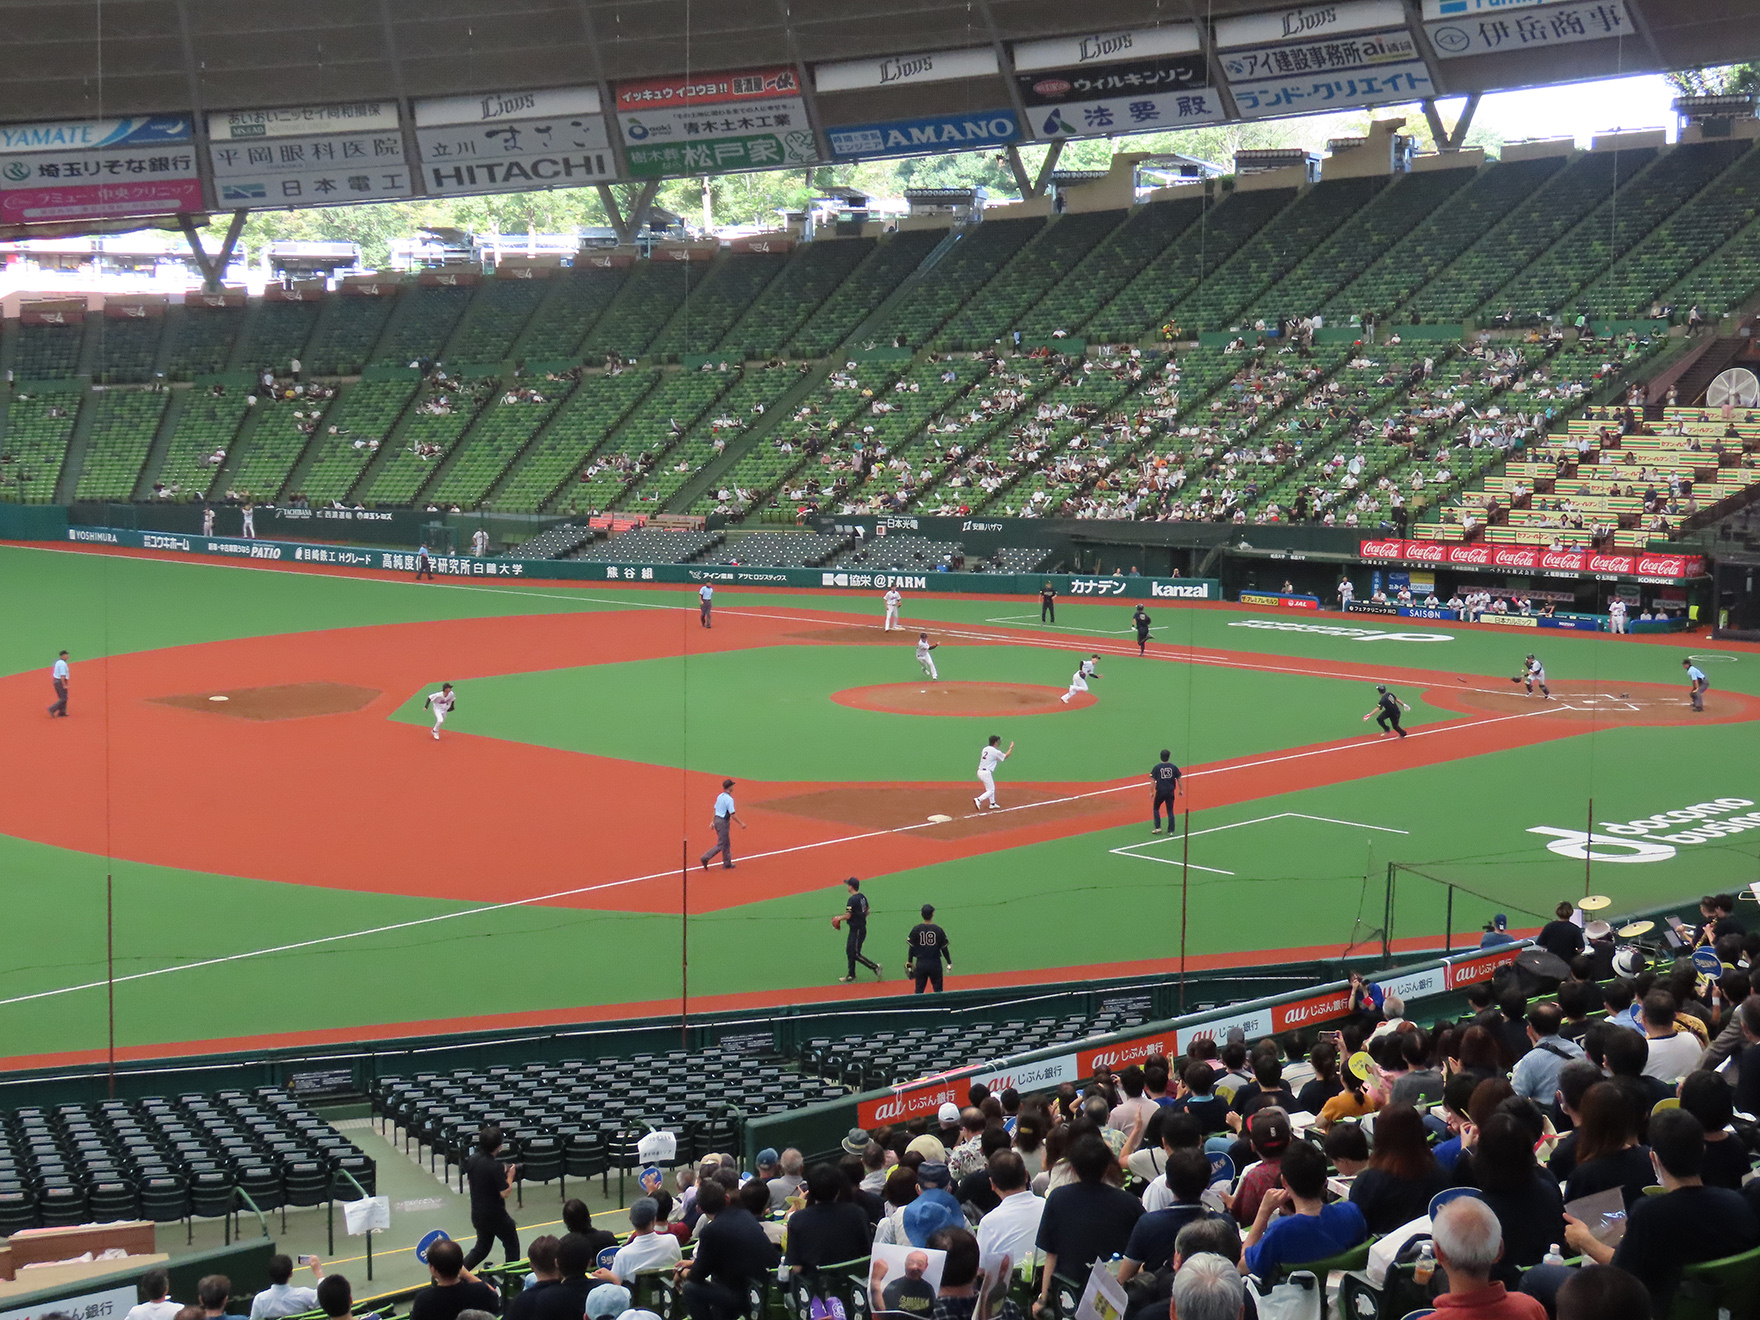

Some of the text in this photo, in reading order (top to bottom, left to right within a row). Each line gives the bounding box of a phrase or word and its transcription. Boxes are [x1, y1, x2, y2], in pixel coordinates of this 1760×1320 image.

[1281, 8, 1337, 38] Lions
[1079, 33, 1133, 63] Lions
[1242, 41, 1363, 76] アイ建設事務所
[879, 56, 933, 84] Lions
[1035, 83, 1070, 93] WILKINSON
[1073, 68, 1193, 92] ウィルキンソン
[622, 87, 673, 103] イッキュウ
[228, 104, 381, 125] あいおいニッセイ同和損保
[480, 93, 536, 120] Lions
[1084, 95, 1212, 127] 法要殿
[683, 114, 791, 135] 青木土木工業
[886, 118, 1014, 148] AMANO
[2, 125, 94, 147] YAMATE
[218, 138, 400, 167] 平岡眼科医院
[682, 139, 781, 168] 松戸家
[37, 155, 192, 178] 埼玉りそな銀行
[432, 154, 605, 187] HITACHI
[282, 174, 404, 197] 日本電工
[887, 518, 919, 530] 日本光電
[75, 530, 117, 543] YOSHIMURA
[250, 546, 281, 560] PATIO
[339, 552, 372, 565] Hグレード
[1363, 541, 1399, 558] Coca-Cola
[1407, 543, 1443, 560] Coca-Cola
[1451, 546, 1487, 564] Coca-Cola
[1496, 548, 1534, 566] Coca-Cola
[1543, 551, 1581, 569] Coca-Cola
[1590, 553, 1631, 572] Coca-Cola
[1639, 557, 1678, 575] Coca-Cola
[606, 566, 654, 580] 熊谷組
[849, 574, 872, 587] 協栄
[1638, 577, 1674, 586] KONOIKE
[1071, 579, 1127, 595] カナデン
[1409, 609, 1441, 619] SAISON
[1160, 767, 1172, 778] 13
[1598, 797, 1755, 835] docomo
[919, 931, 936, 946] 18
[1456, 965, 1479, 982] au
[1397, 978, 1433, 996] じぶん銀行
[1285, 998, 1349, 1024] au じぶん銀行
[1092, 1041, 1164, 1070] au じぶん銀行
[988, 1066, 1063, 1092] au じぶん銀行
[875, 1090, 956, 1121] au じぶん銀行
